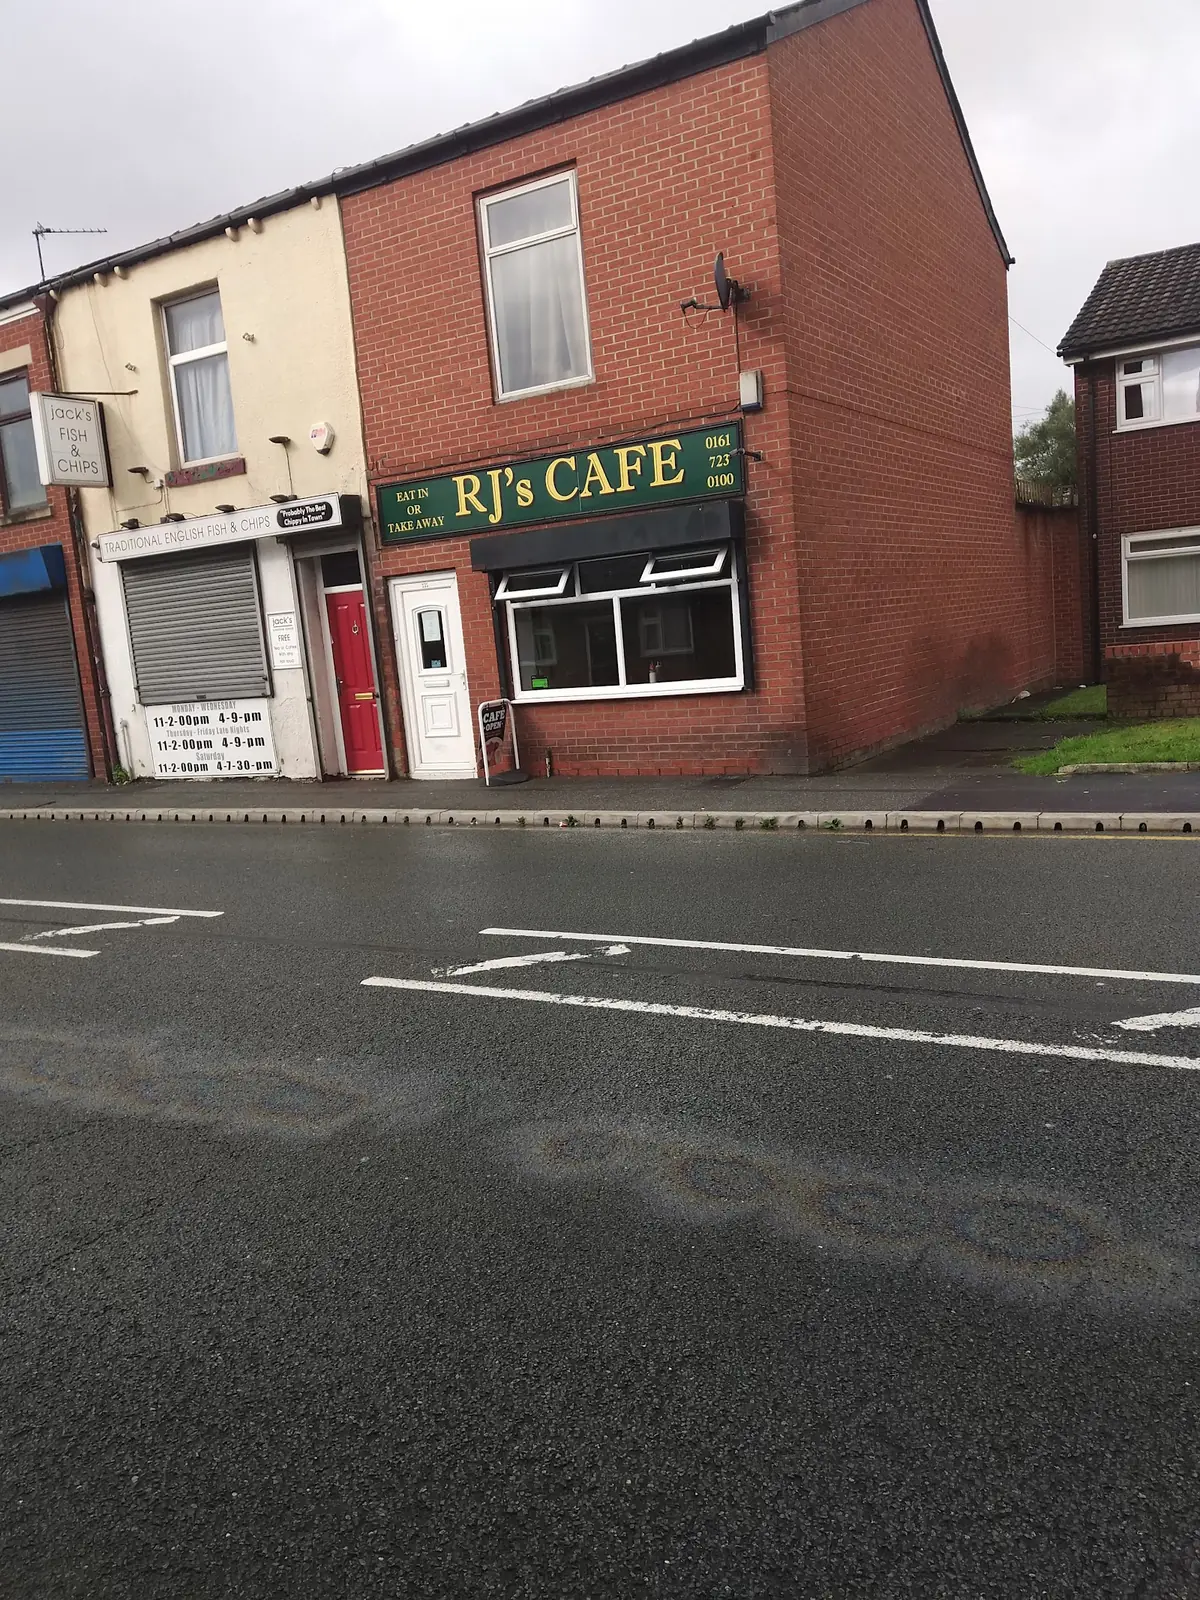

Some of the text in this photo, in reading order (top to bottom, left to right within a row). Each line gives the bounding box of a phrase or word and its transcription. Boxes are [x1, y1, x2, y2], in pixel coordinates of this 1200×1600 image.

[51, 404, 92, 422] jack's
[59, 427, 88, 442] FISH
[705, 434, 731, 450] 0161
[71, 444, 80, 457] &
[57, 458, 98, 475] CHIPS
[708, 452, 731, 468] 723
[452, 438, 686, 524] RJ's CAFE
[706, 472, 735, 489] 0100
[396, 487, 429, 502] EAT IN
[305, 505, 315, 514] The
[316, 503, 326, 512] Best
[406, 503, 422, 516] OR
[284, 516, 302, 527] Chippy
[302, 515, 308, 523] In
[387, 515, 445, 534] TAKE AWAY
[105, 515, 270, 553] TRADITIONAL ENGLISH FISH & CHIPS
[278, 633, 291, 642] FREE
[171, 703, 196, 714] MONDAY
[200, 701, 237, 712] WEDNESDAY
[153, 711, 262, 728] 11-2-00pm 4-9-pm
[485, 721, 502, 731] OPEN
[166, 728, 193, 738] Thursday
[197, 727, 215, 736] Friday
[230, 725, 250, 735] Nights
[157, 736, 265, 751] 11-2-00pm 4-9-pm
[195, 751, 225, 762] Saturday
[158, 760, 273, 773] 11-2-00pm 4-7-30-pm
